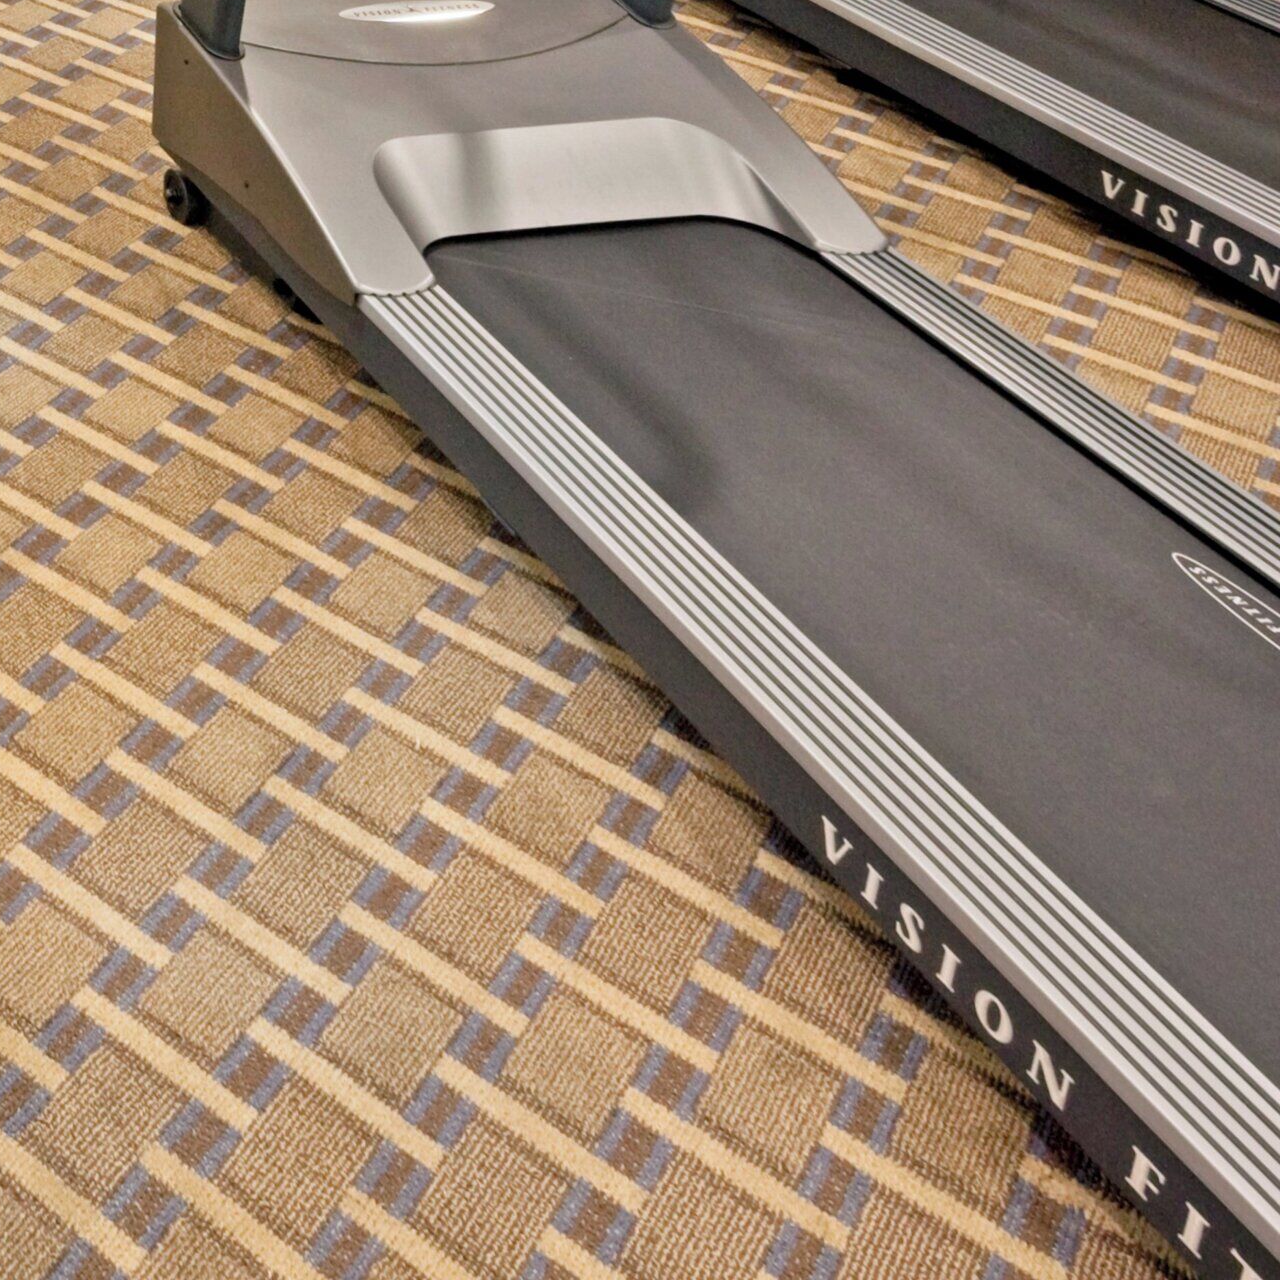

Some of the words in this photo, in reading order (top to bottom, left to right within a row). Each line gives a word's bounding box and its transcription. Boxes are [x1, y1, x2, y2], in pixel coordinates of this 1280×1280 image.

[354, 8, 401, 17] VISION
[424, 3, 480, 13] FITNESS
[1101, 170, 1280, 290] VISION
[821, 815, 1075, 1112] VISION
